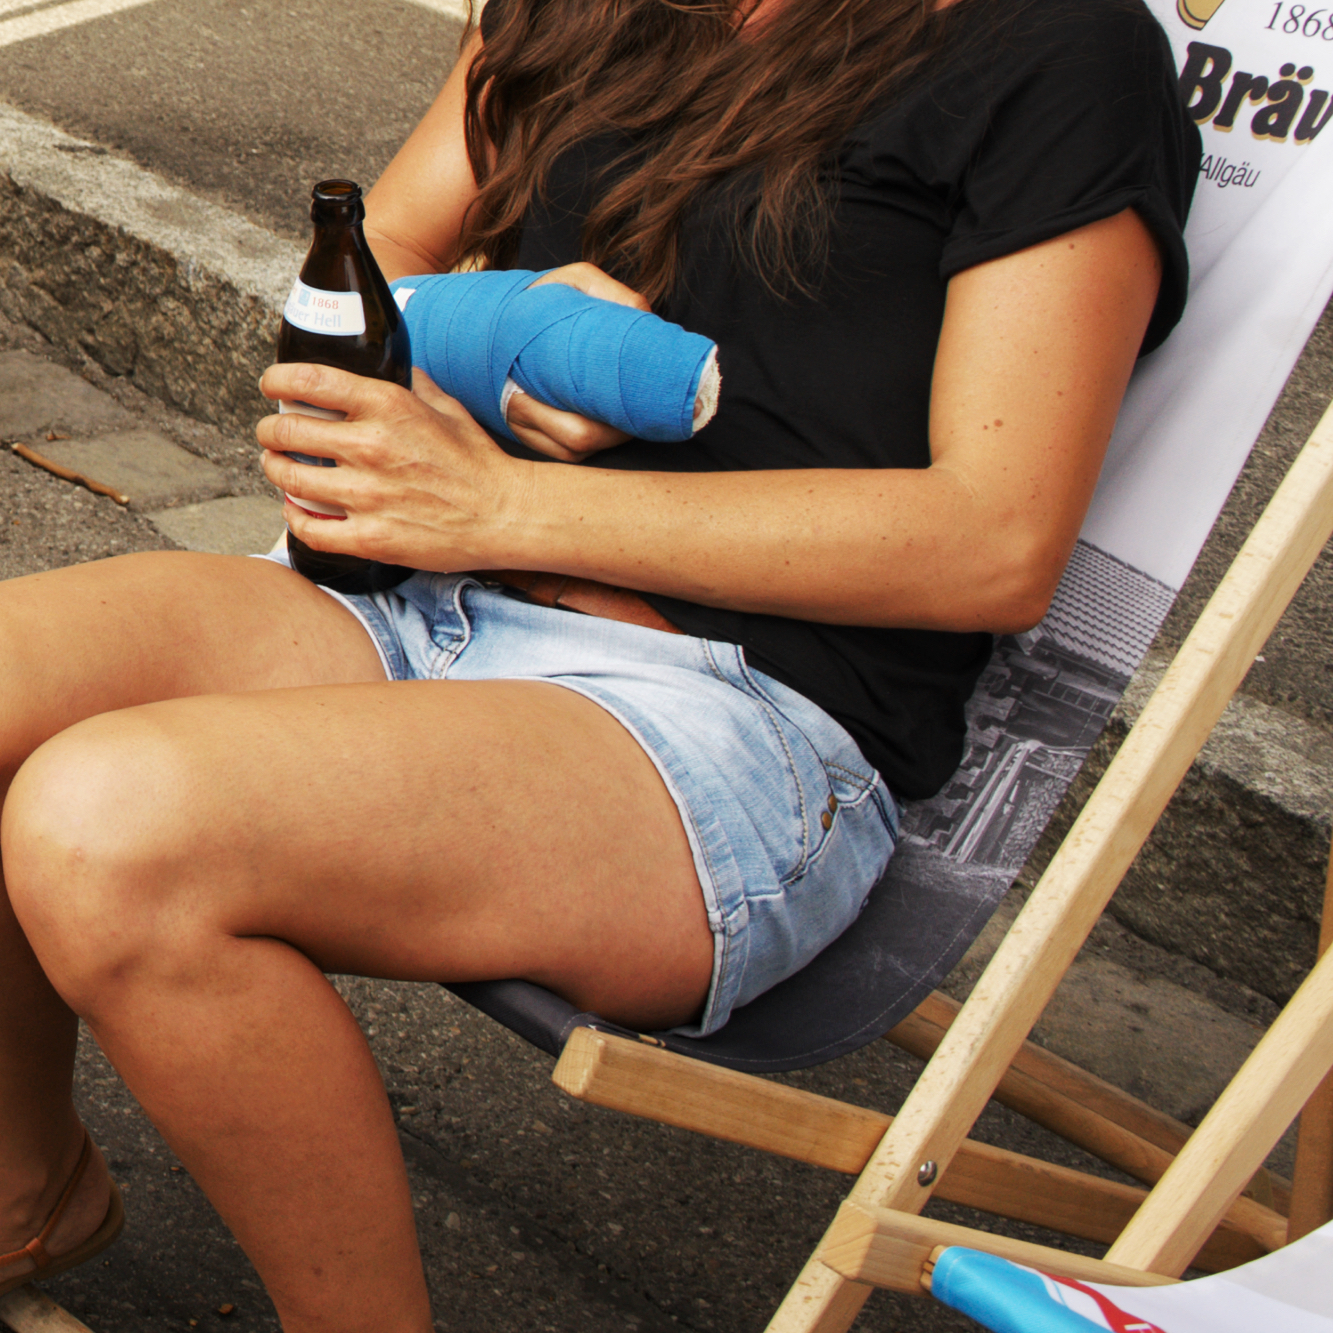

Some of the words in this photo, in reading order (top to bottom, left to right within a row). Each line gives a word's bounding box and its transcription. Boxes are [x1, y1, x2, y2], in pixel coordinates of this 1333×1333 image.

[1264, 0, 1333, 41] 1868
[1179, 41, 1333, 146] Bräu
[312, 296, 339, 310] 1868
[314, 311, 342, 328] Hell
